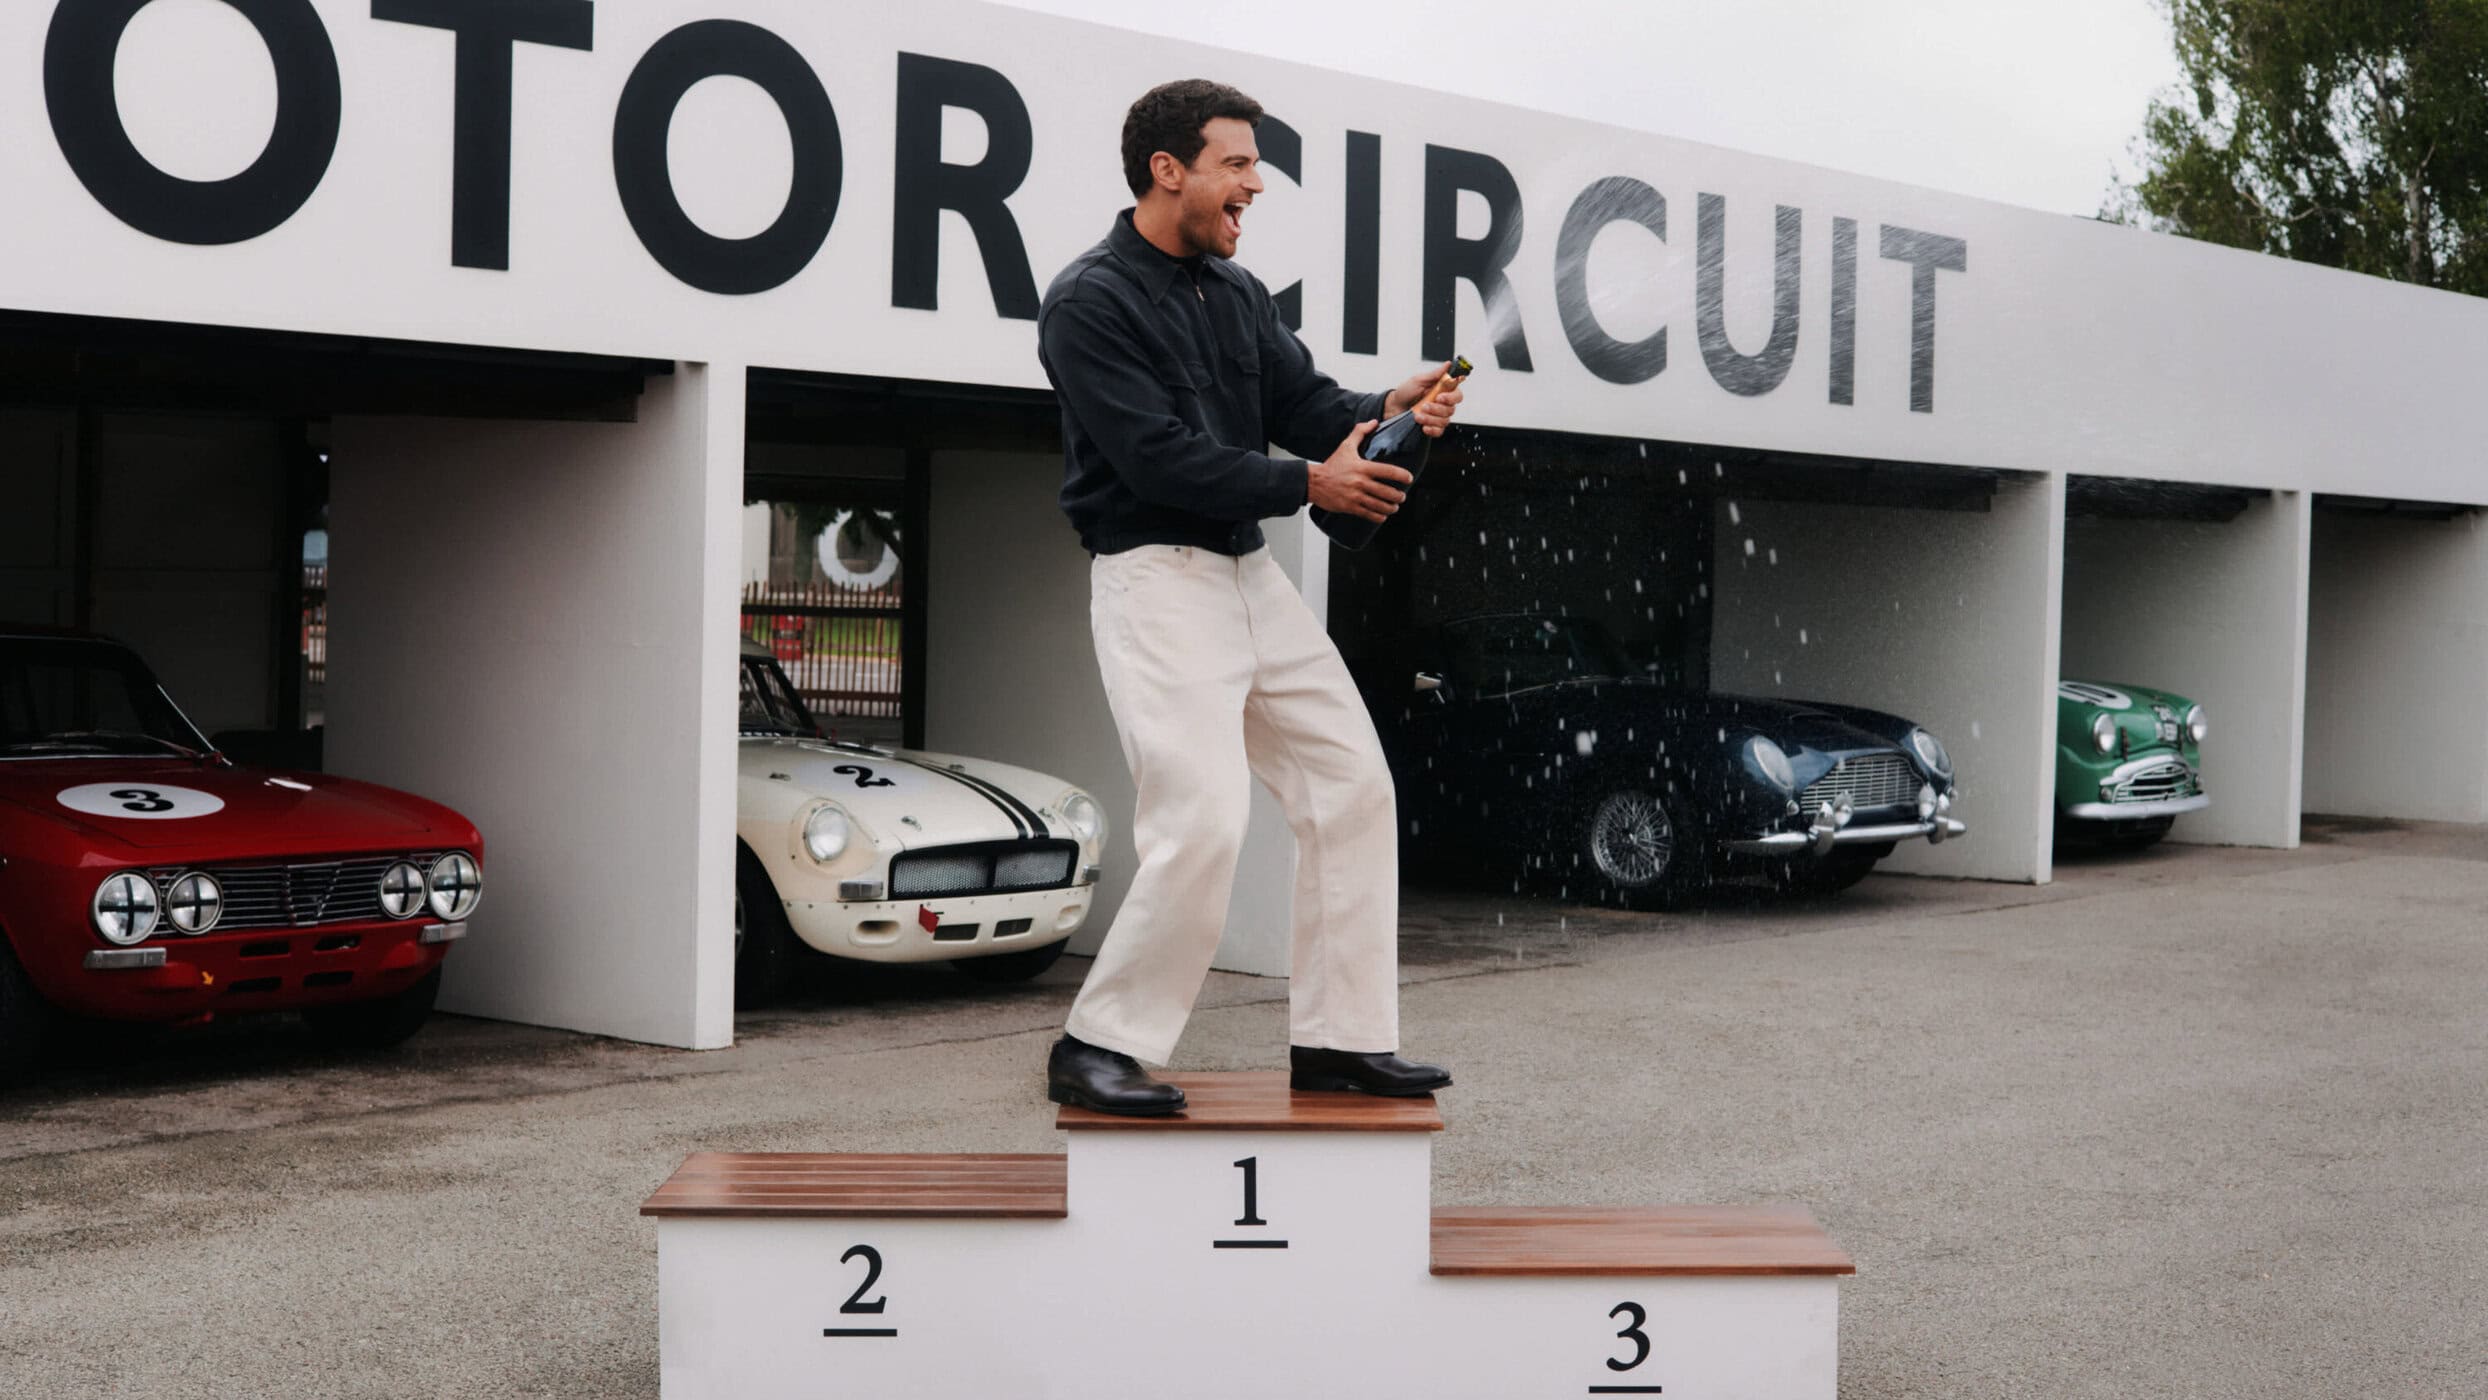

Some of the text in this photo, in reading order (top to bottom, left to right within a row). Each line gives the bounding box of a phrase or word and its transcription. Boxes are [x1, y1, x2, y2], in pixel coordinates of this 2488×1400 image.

[109, 788, 175, 812] 3
[833, 764, 896, 789] 2
[1233, 1156, 1267, 1226] 1
[839, 1244, 887, 1314] 2
[1606, 1301, 1651, 1372] 3
